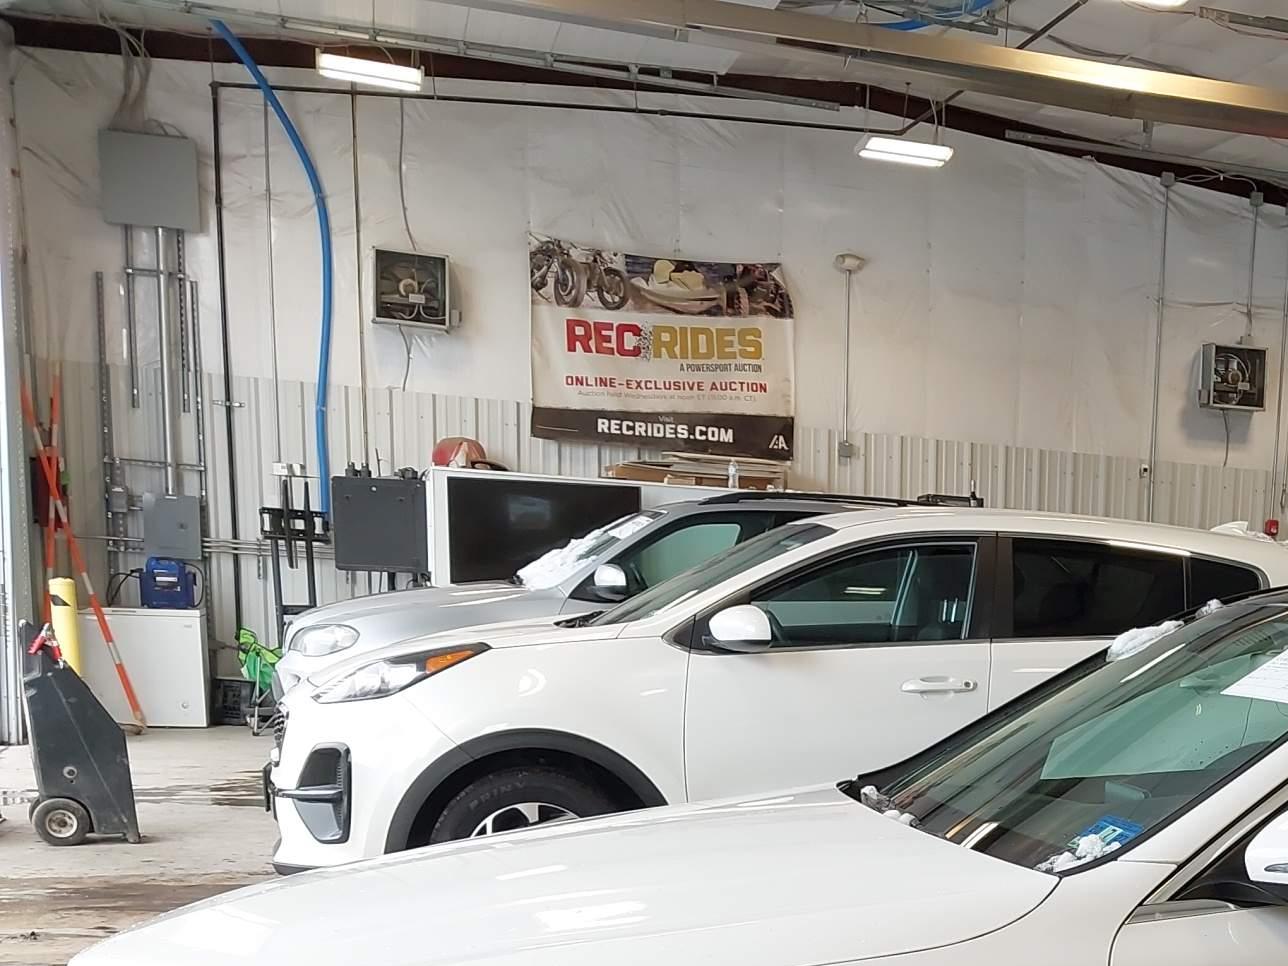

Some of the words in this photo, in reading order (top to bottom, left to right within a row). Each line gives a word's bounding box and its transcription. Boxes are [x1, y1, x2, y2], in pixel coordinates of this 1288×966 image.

[566, 319, 642, 358] REC
[653, 325, 763, 361] RIDES
[680, 362, 686, 373] A
[686, 362, 732, 373] POWERSPORT
[734, 362, 762, 373] AUCTION
[565, 375, 705, 392] ONLINE-EXCLUSIVE
[710, 381, 768, 394] AUCTION
[597, 418, 734, 443] RECRIDES.COM
